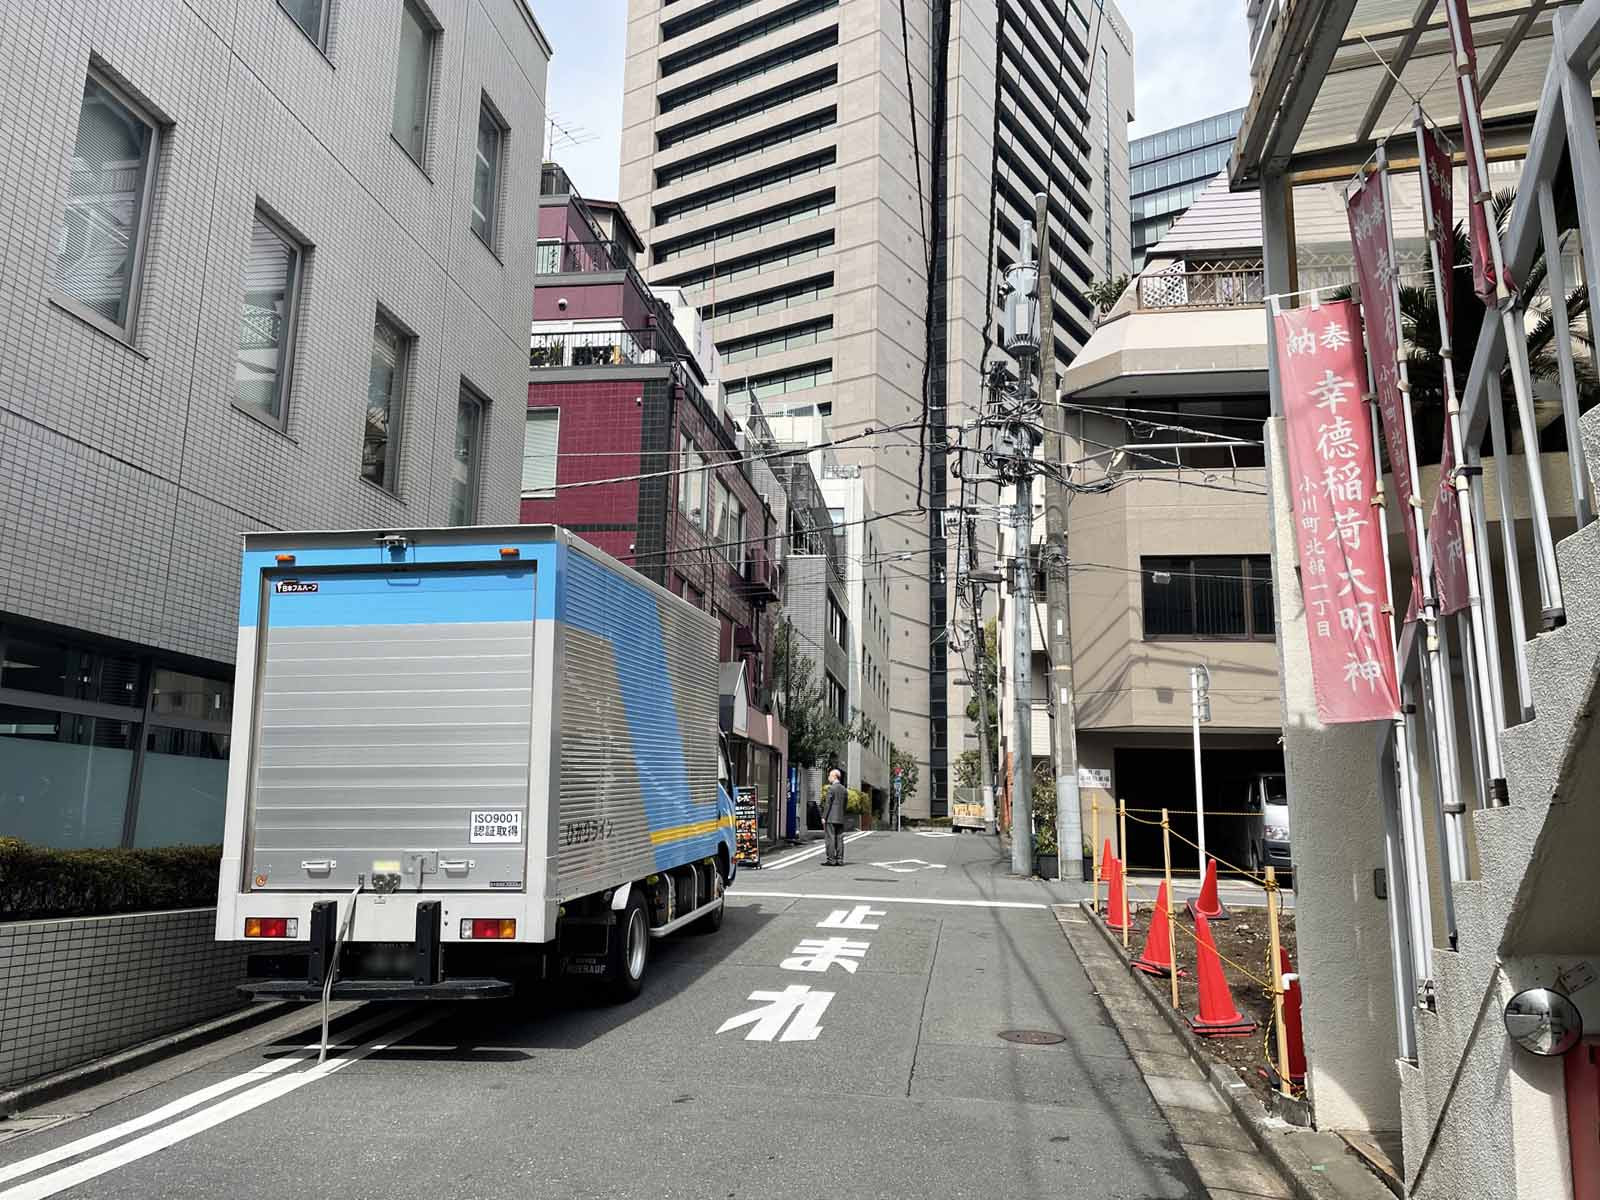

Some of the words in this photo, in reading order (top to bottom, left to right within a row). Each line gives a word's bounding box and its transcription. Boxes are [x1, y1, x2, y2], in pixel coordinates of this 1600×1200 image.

[1285, 321, 1352, 358] 奉納
[1298, 474, 1332, 638] 小川町北部一丁目
[473, 825, 518, 837] 認証取得
[474, 813, 519, 824] ISO9001
[716, 905, 887, 1042] 止まれ
